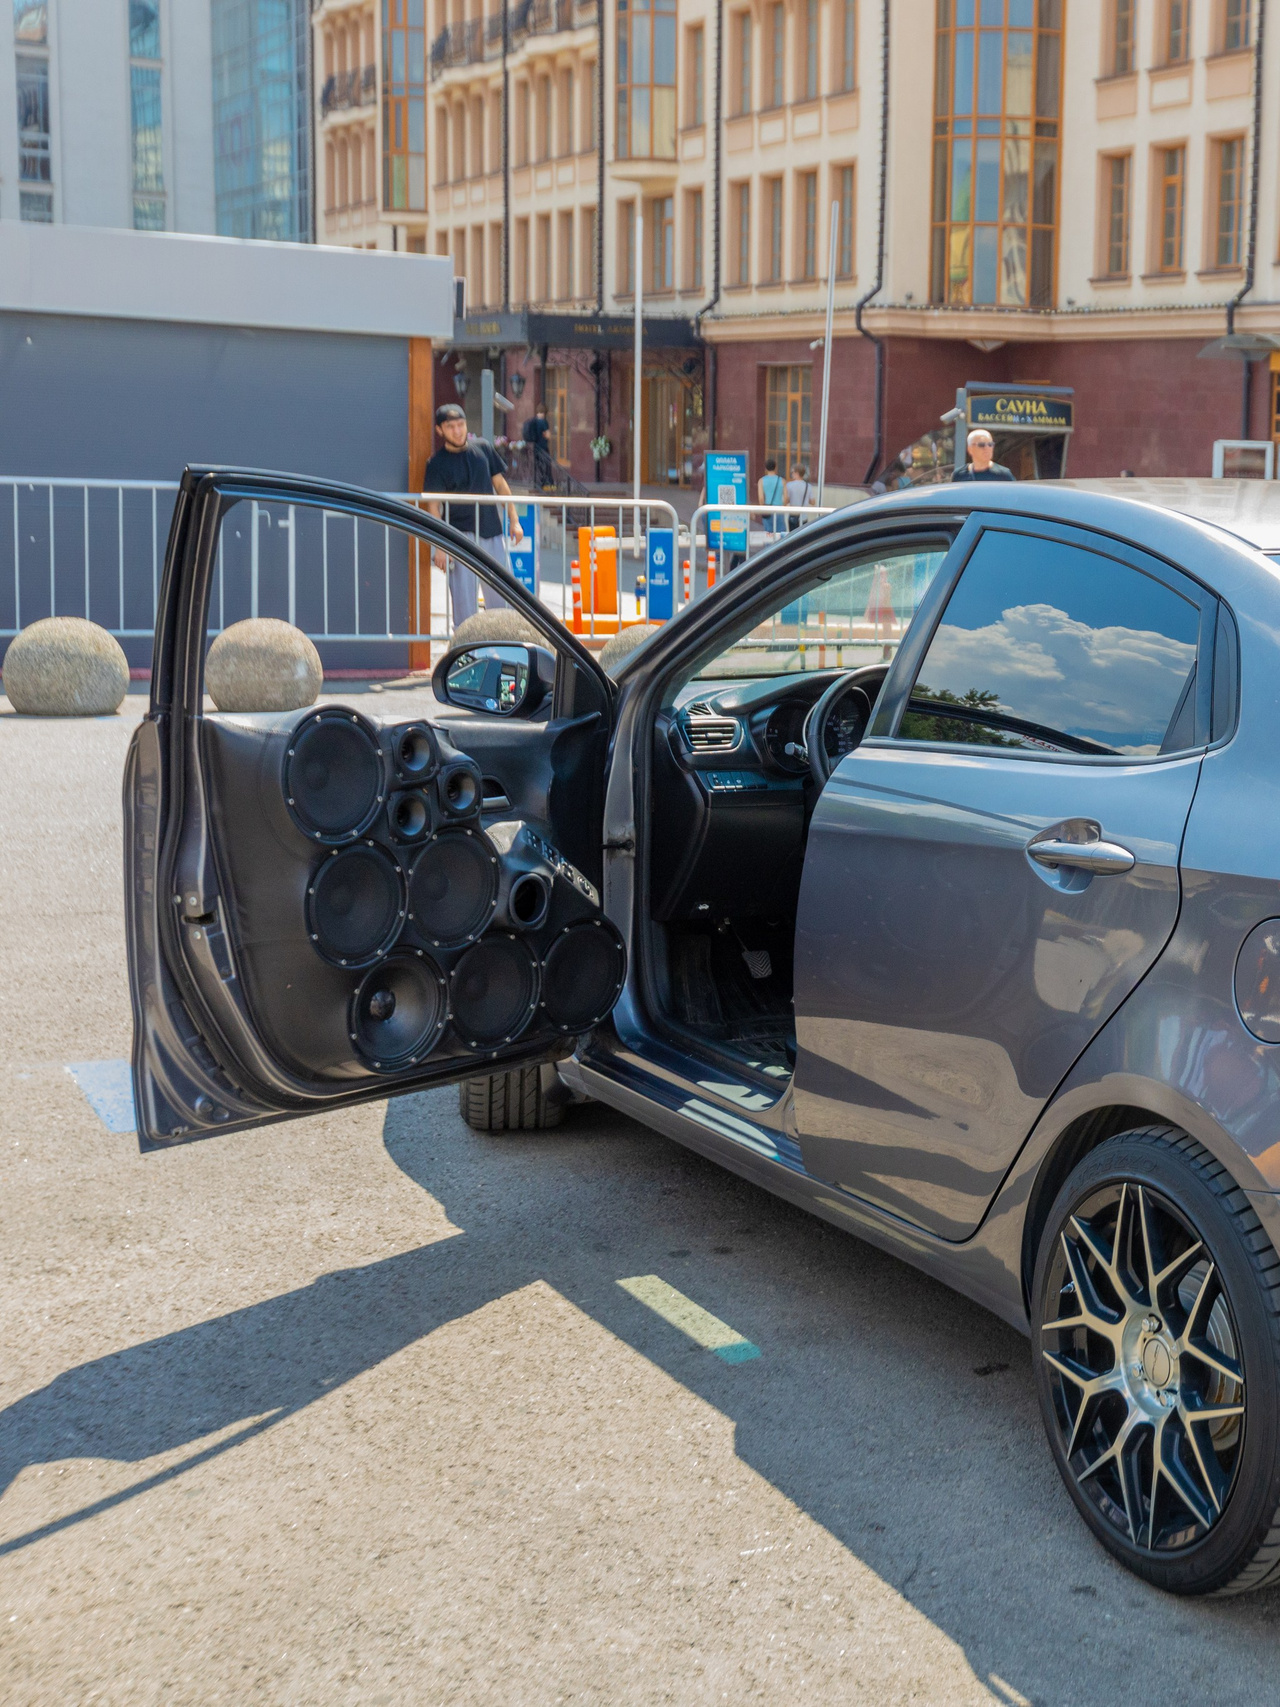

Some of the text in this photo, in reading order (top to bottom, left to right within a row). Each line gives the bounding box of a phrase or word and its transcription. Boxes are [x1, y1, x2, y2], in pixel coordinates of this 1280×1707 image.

[996, 398, 1047, 415] САУНА
[978, 412, 1065, 425] БАССЕЙН ХАММАМ
